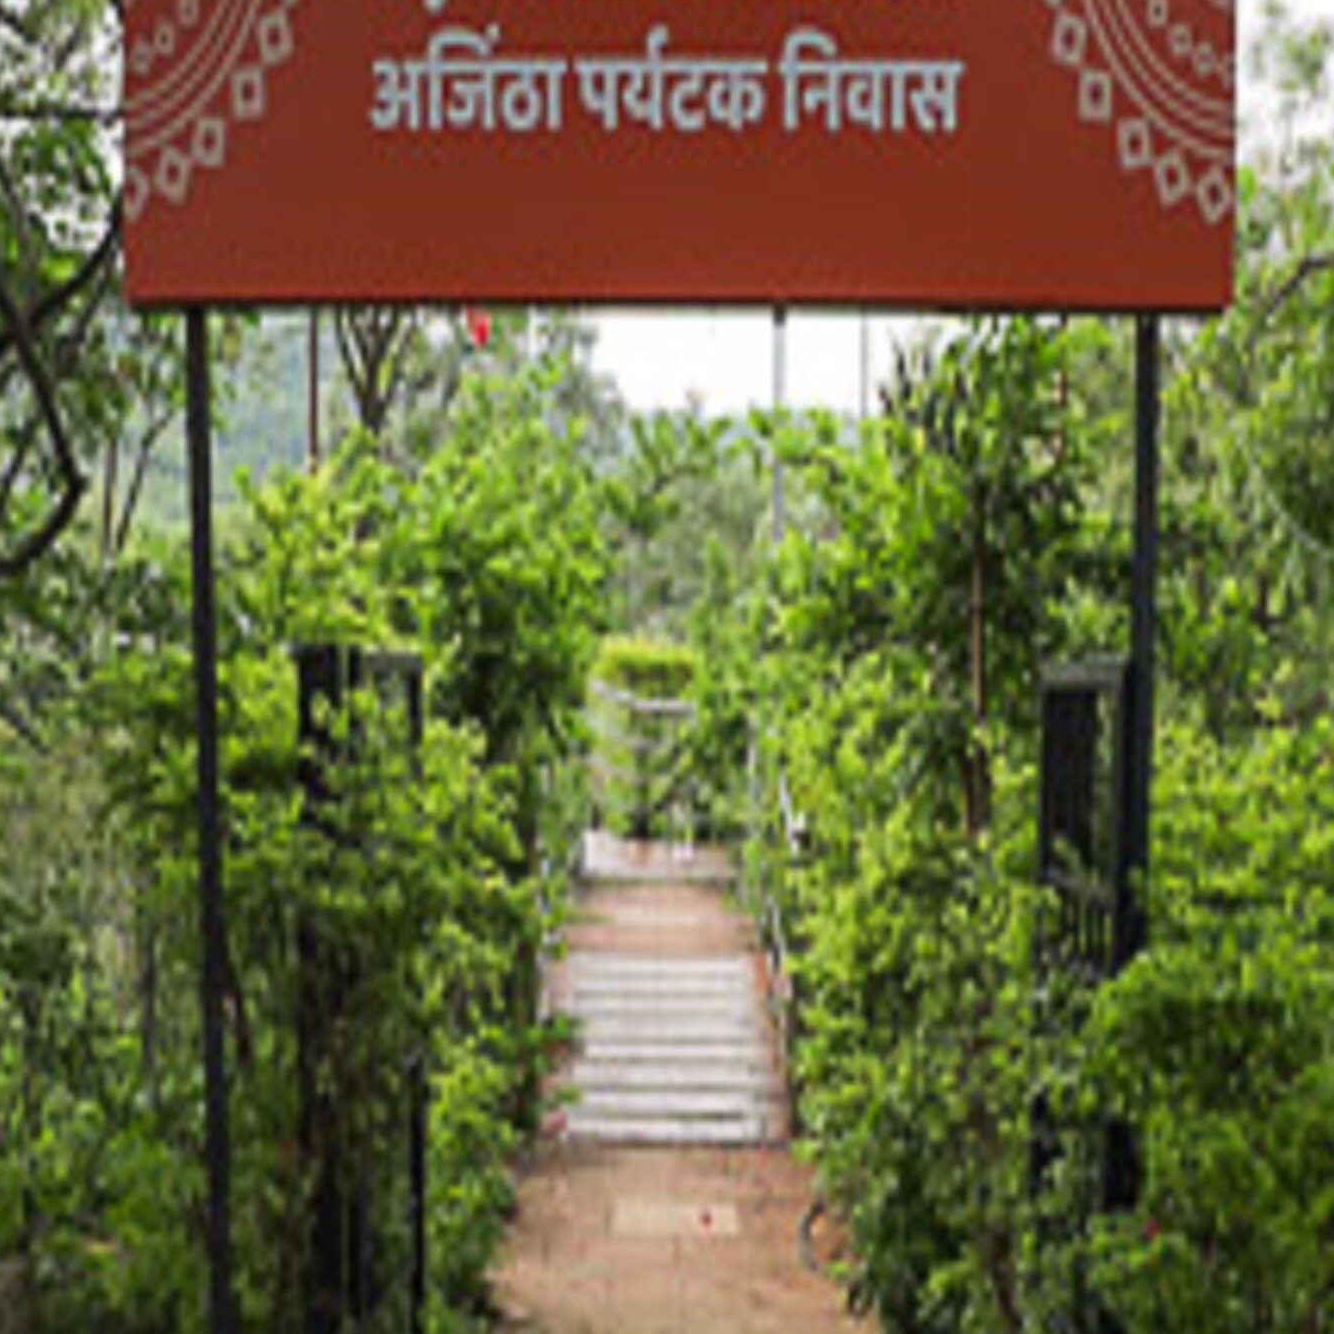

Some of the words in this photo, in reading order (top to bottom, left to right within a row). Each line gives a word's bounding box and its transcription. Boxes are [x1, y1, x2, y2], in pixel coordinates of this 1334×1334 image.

[370, 23, 567, 131] अजिंठा
[573, 24, 768, 131] पर्यटक
[777, 27, 965, 132] निवास
